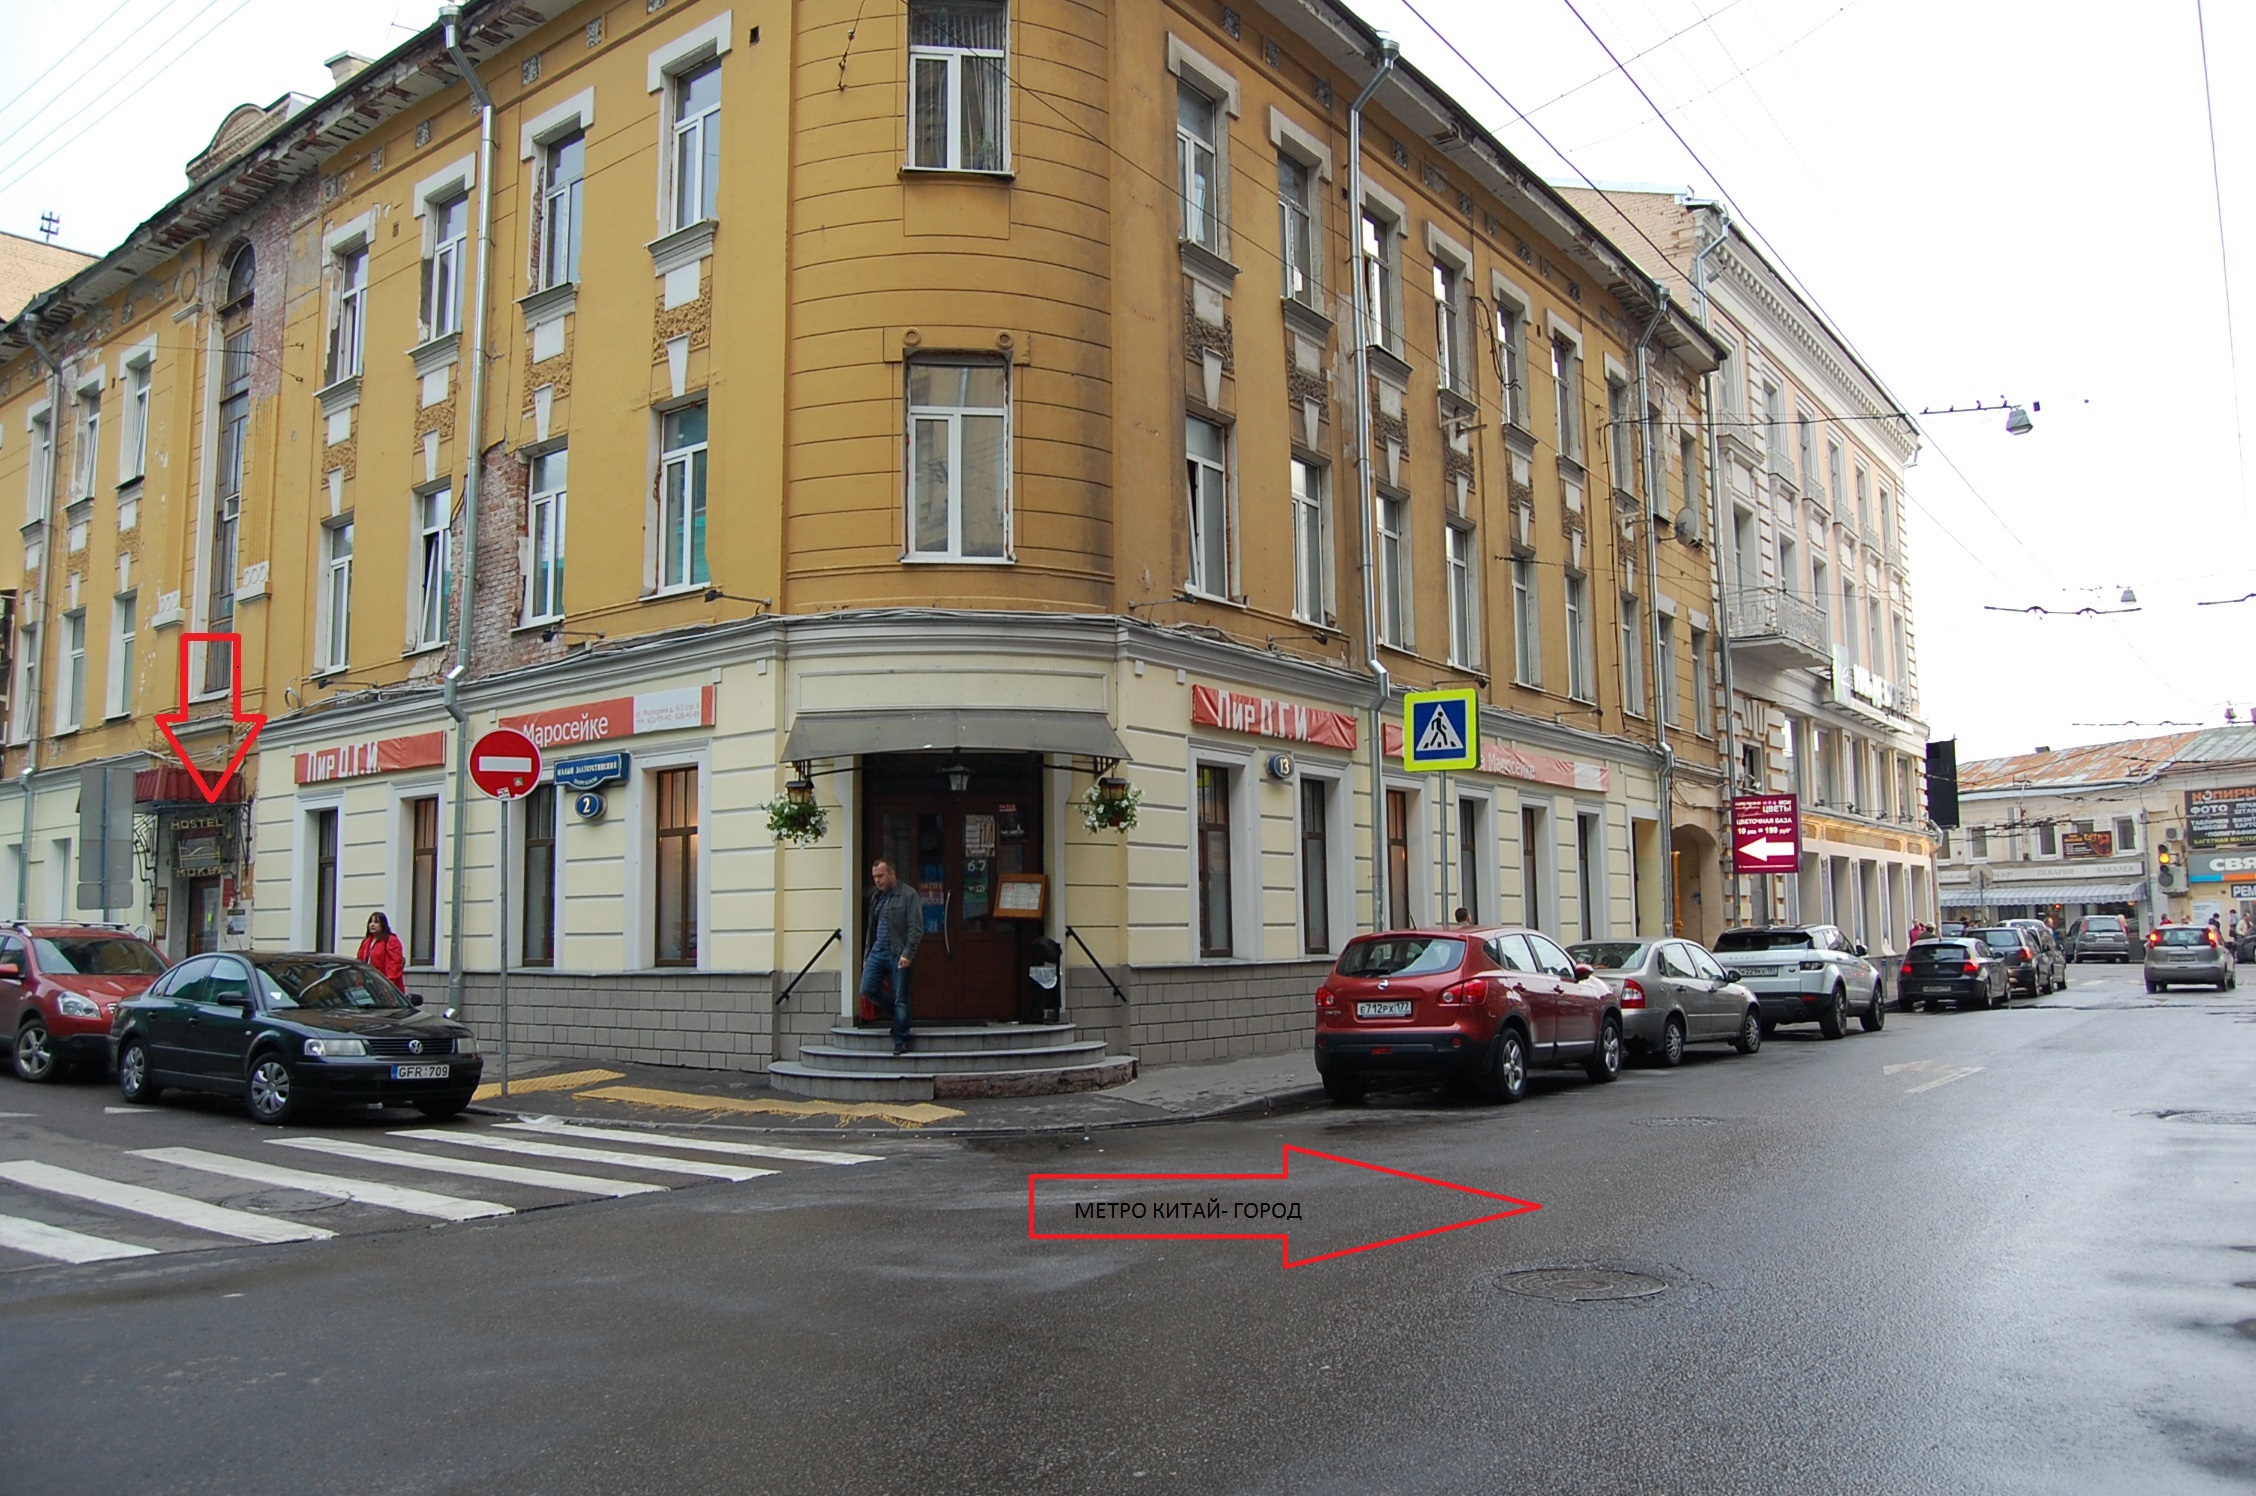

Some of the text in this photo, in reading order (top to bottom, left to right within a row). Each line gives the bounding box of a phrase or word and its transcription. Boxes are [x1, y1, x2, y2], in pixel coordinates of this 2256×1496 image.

[1217, 689, 1255, 732] Пир
[523, 712, 608, 748] Маросейке
[306, 751, 335, 783] Пир
[1279, 757, 1290, 775] 13
[582, 797, 591, 813] 2
[1762, 805, 1792, 813] ЦВЕТЫ
[2190, 804, 2228, 814] ФОТО
[171, 818, 224, 830] HOSTEL
[1737, 827, 1746, 835] 10
[2037, 868, 2074, 876] ПЕКАРНЯ
